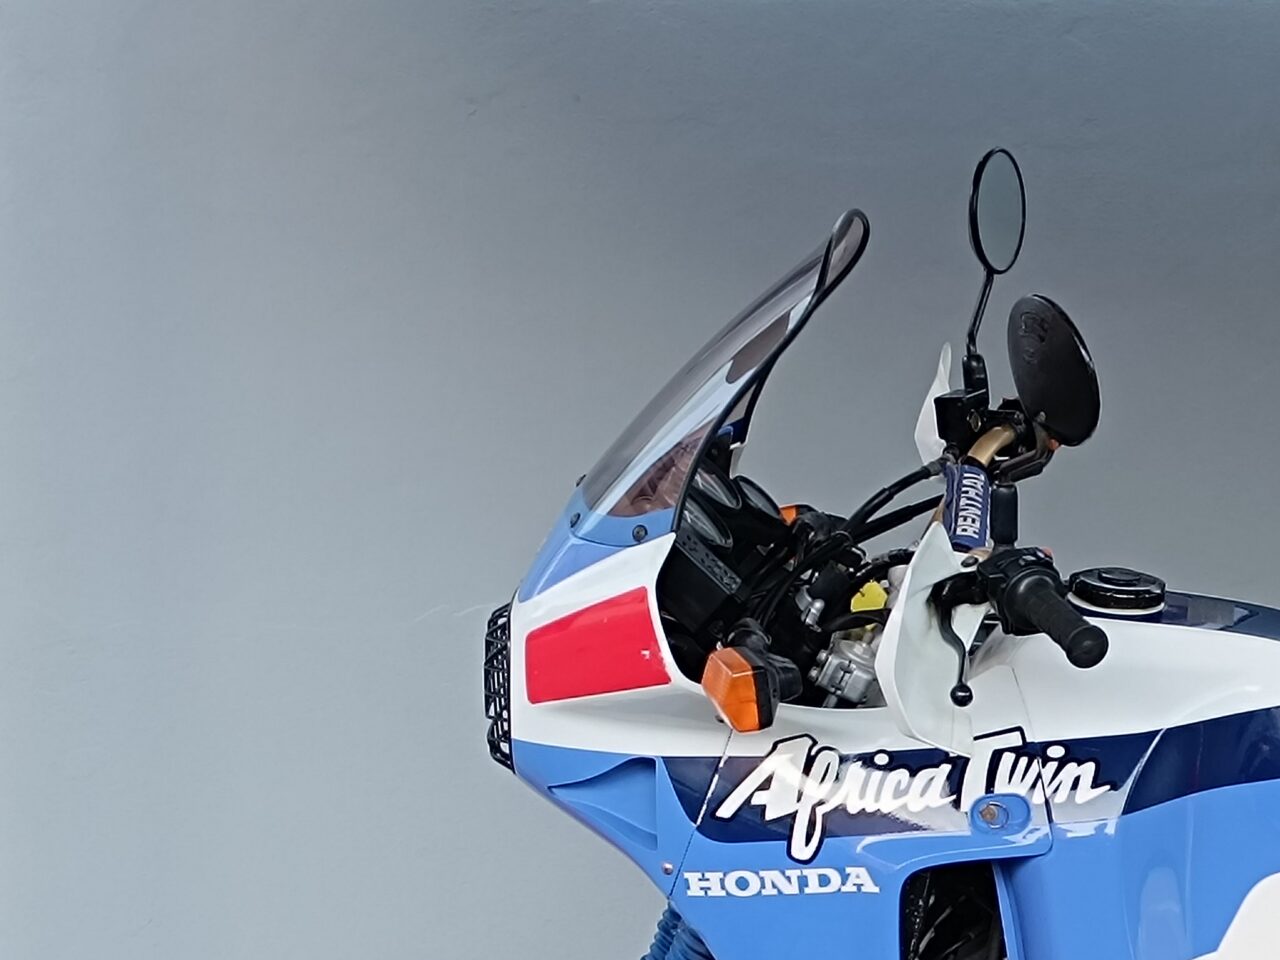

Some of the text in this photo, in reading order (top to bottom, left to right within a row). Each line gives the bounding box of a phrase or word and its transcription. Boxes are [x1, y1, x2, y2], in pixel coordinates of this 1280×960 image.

[955, 472, 985, 538] RENTHAL
[715, 726, 1113, 863] Africa Twin
[683, 866, 880, 897] HONDA
